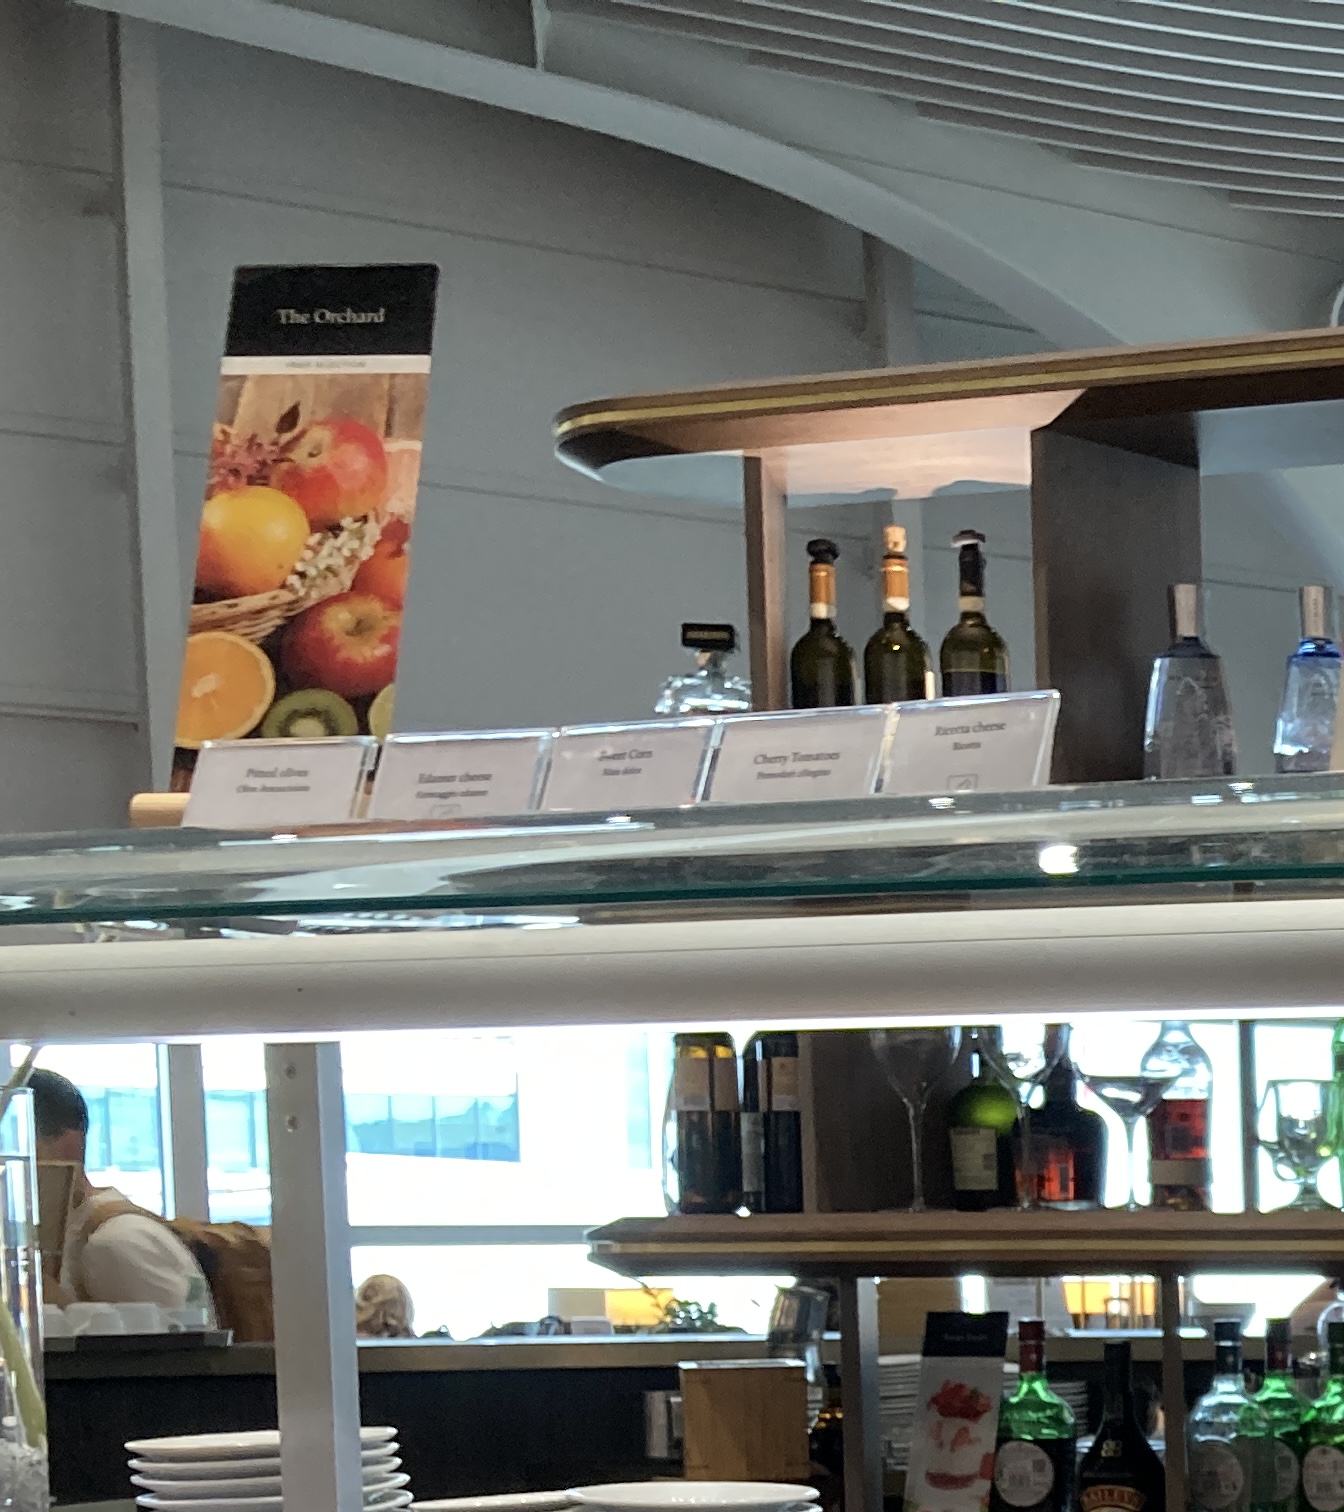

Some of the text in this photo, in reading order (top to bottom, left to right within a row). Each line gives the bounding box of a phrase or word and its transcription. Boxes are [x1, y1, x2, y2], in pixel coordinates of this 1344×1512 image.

[276, 307, 386, 324] The Orchard
[934, 721, 1007, 736] Ricotta cheese
[753, 753, 790, 767] Cherry
